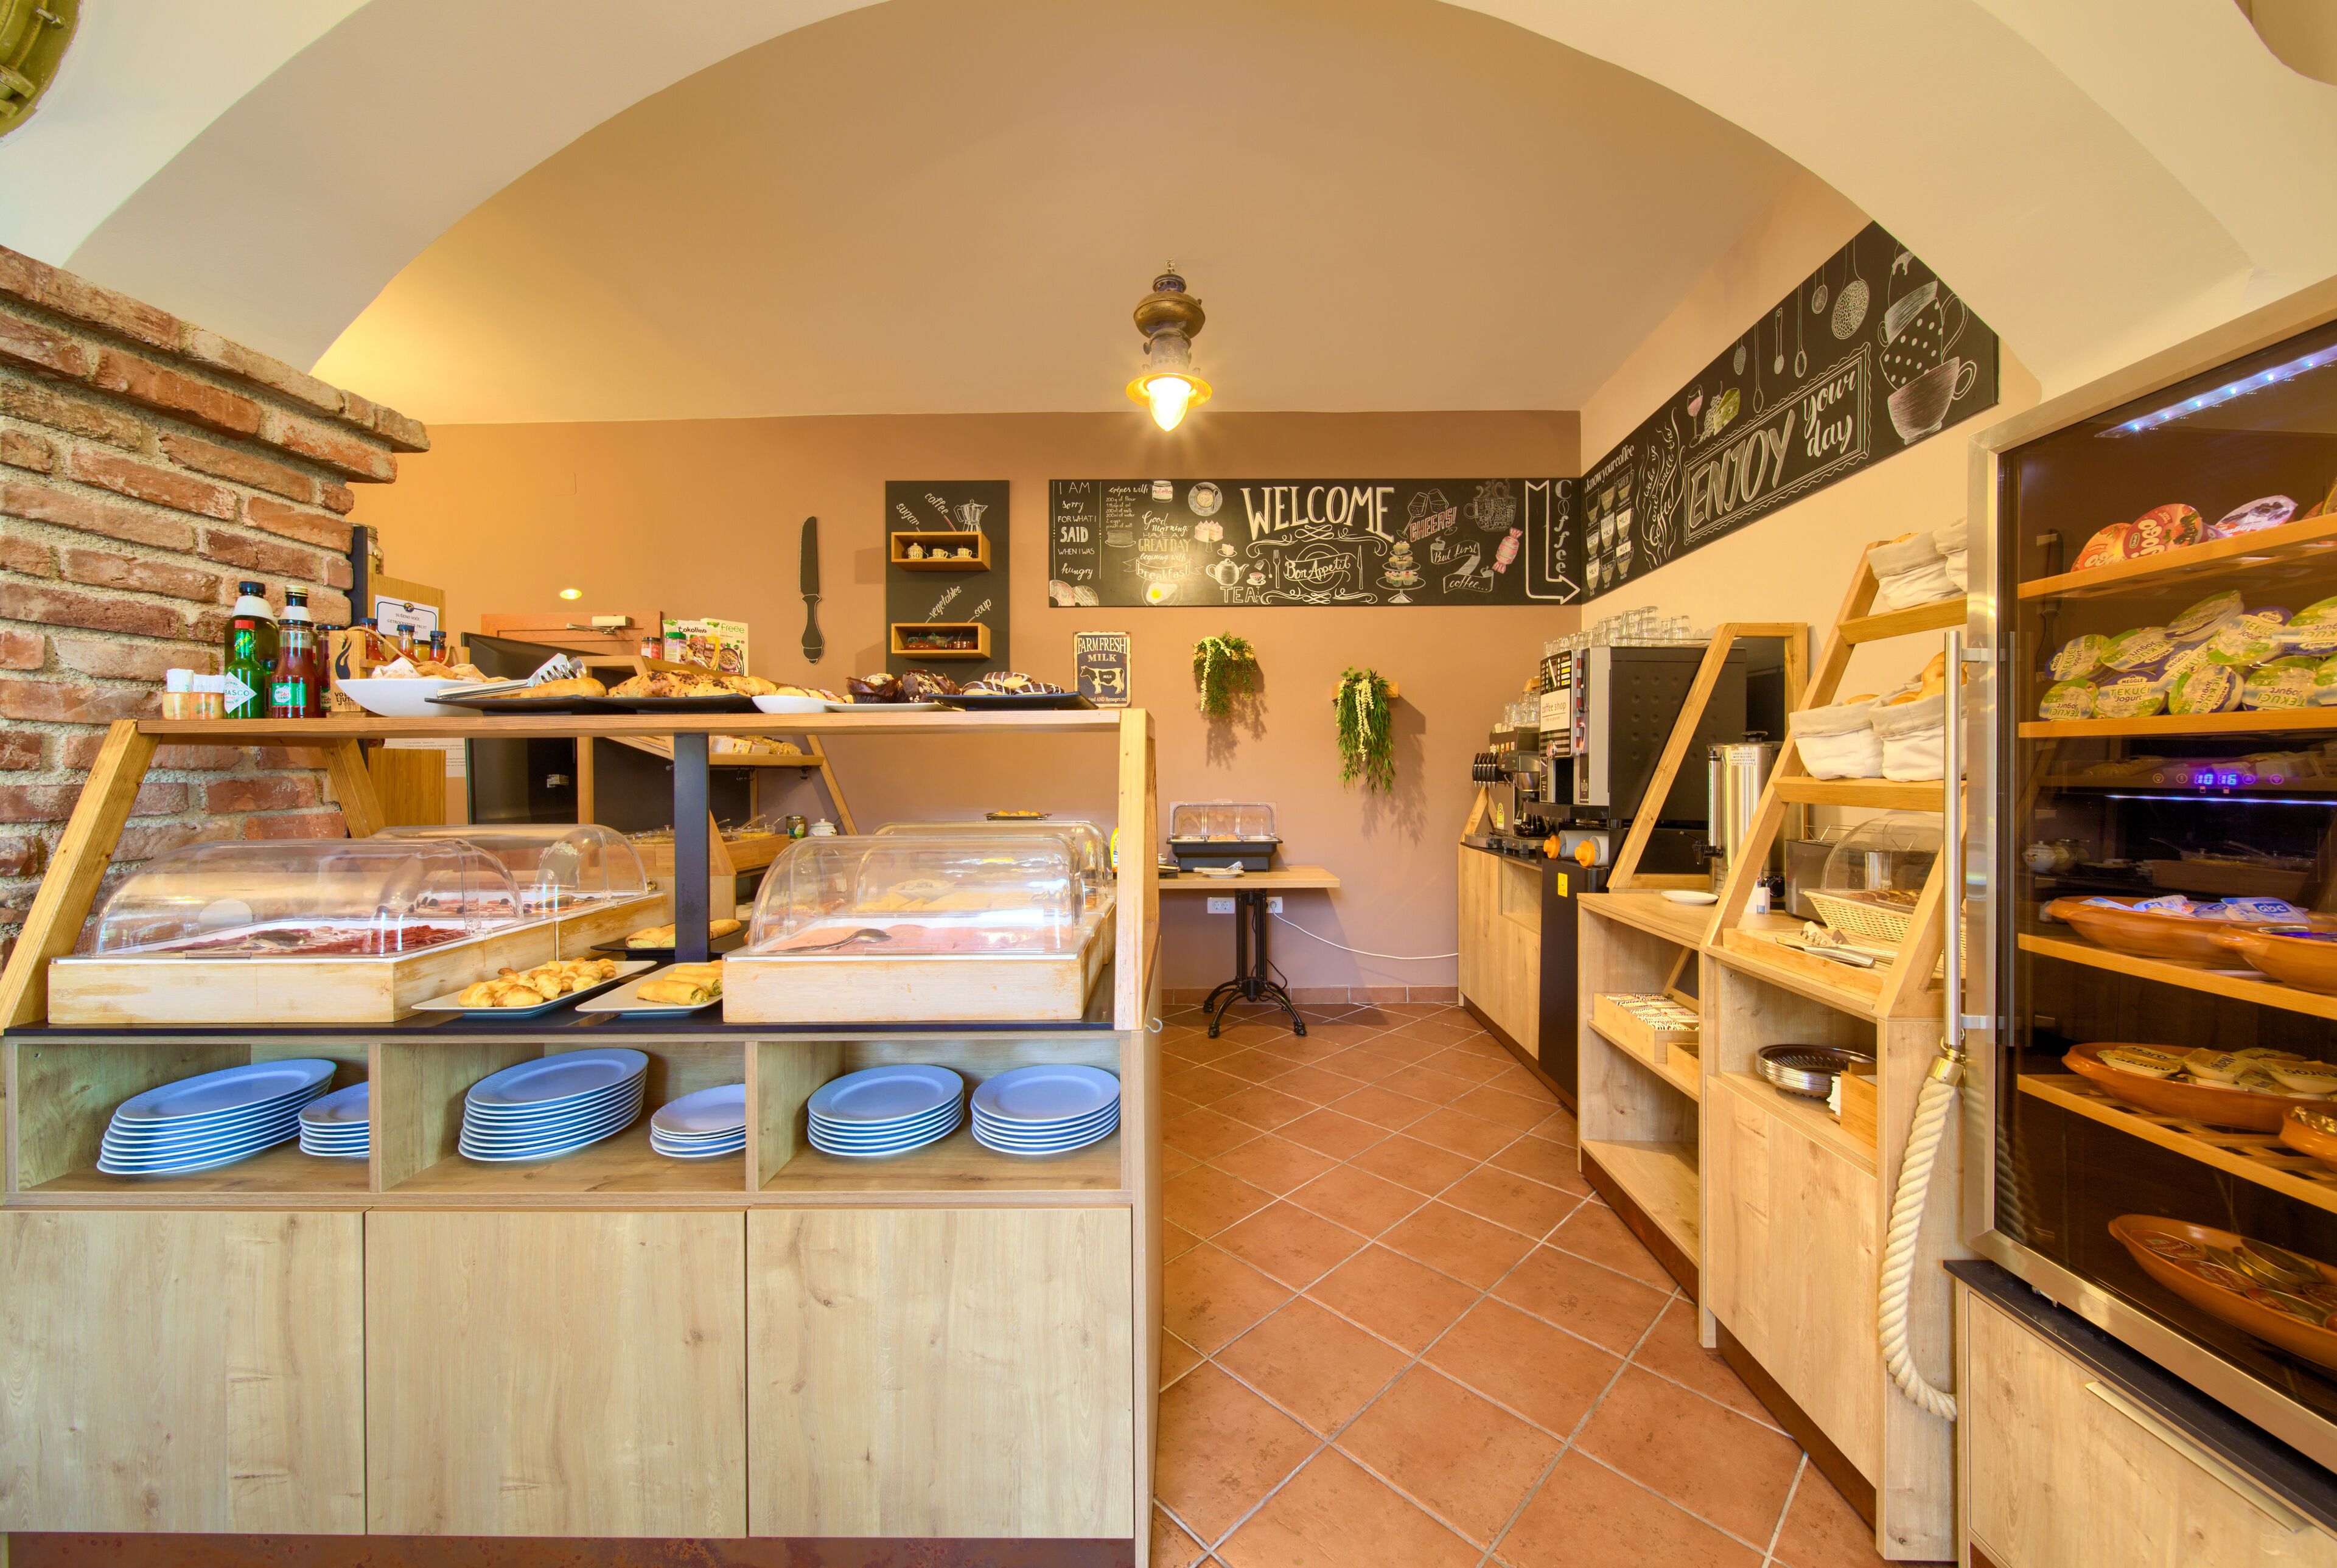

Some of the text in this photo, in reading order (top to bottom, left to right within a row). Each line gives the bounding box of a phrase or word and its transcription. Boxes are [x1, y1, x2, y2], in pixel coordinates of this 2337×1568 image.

[1803, 370, 1856, 439] your
[1807, 415, 1853, 458] day
[1587, 445, 1635, 492] know your coffee
[1689, 409, 1795, 528] ENJOY
[1060, 481, 1091, 495] I AM
[1133, 484, 1148, 493] with
[924, 493, 949, 515] coffee
[1062, 500, 1085, 514] sorry
[896, 503, 920, 526] sugar
[1142, 510, 1169, 531] Good
[1240, 486, 1396, 543] WELCOME
[1410, 506, 1457, 543] CHEERS!
[1060, 526, 1089, 543] SAID
[1138, 538, 1191, 552] GREAT DAY
[1433, 543, 1478, 563] But first
[1171, 553, 1187, 562] with
[1061, 563, 1094, 580] hungry
[1137, 563, 1188, 580] breakfast
[1285, 554, 1351, 581] Bon Appetit
[929, 585, 962, 618] vegetables
[1220, 586, 1257, 603] TEA
[974, 599, 992, 618] soup
[721, 623, 745, 634] freee
[2241, 620, 2276, 635] TEKUĆI
[1077, 637, 1127, 654] FARM FRESH
[2129, 641, 2157, 657] Jogurt
[1088, 653, 1117, 662] MILK
[2062, 647, 2077, 673] TEKUĆI
[2167, 651, 2189, 668] MEGGLE
[2110, 685, 2150, 696] TEKUĆI
[2196, 681, 2213, 704] Jogurt
[2198, 675, 2223, 711] TEKUĆI
[1542, 700, 1567, 714] coffee shop
[2257, 693, 2307, 706] TEKUĆI
[2049, 708, 2080, 717] TEKUĆI
[2258, 904, 2287, 913] abc
[2115, 1057, 2171, 1071] Margo
